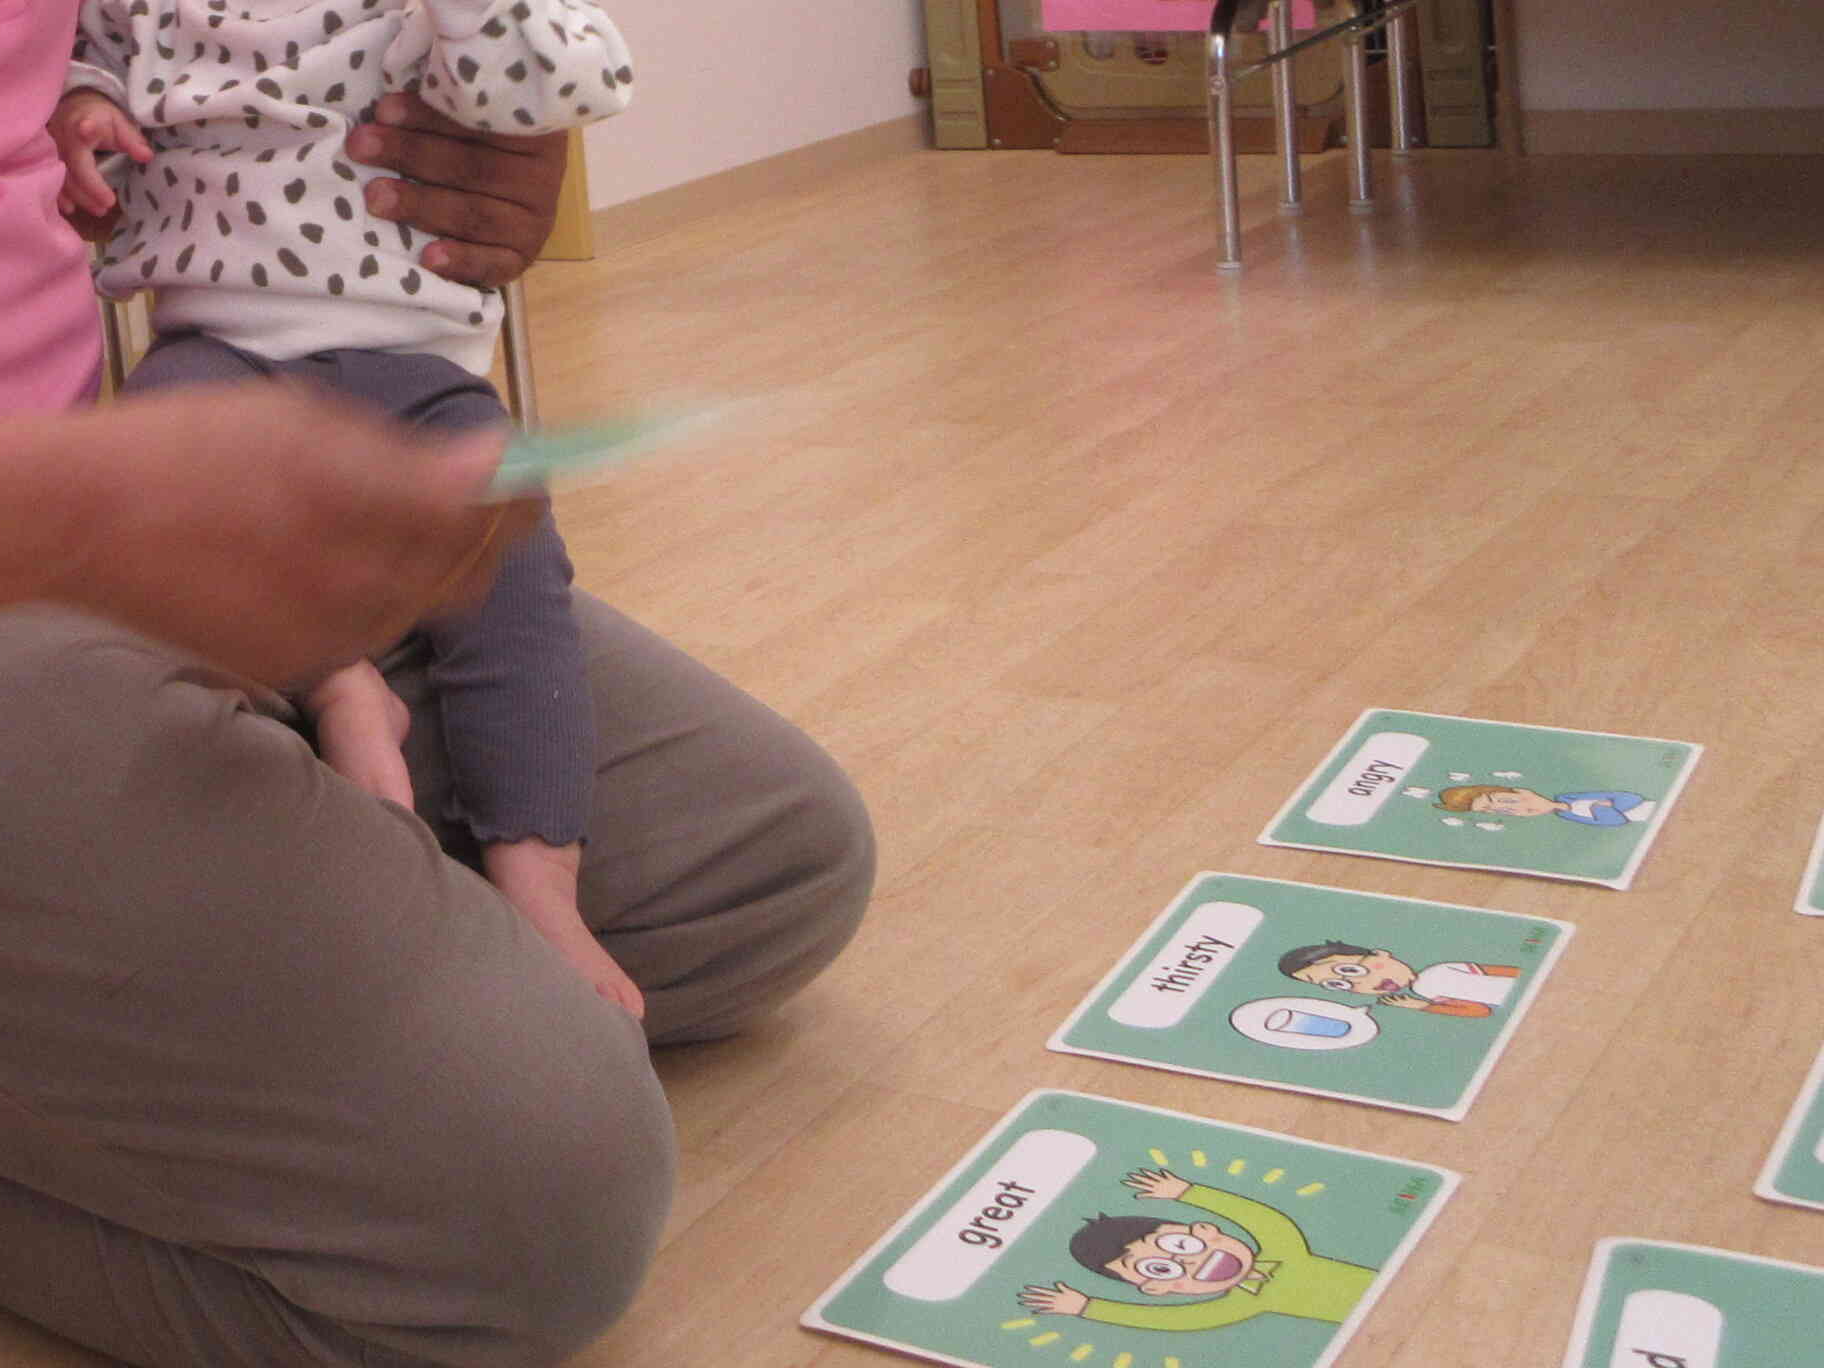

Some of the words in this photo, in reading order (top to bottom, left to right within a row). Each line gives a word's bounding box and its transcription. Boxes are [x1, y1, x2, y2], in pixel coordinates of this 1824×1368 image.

[1348, 760, 1404, 796] angry
[1151, 935, 1235, 992] thirsty
[958, 1181, 1036, 1249] great
